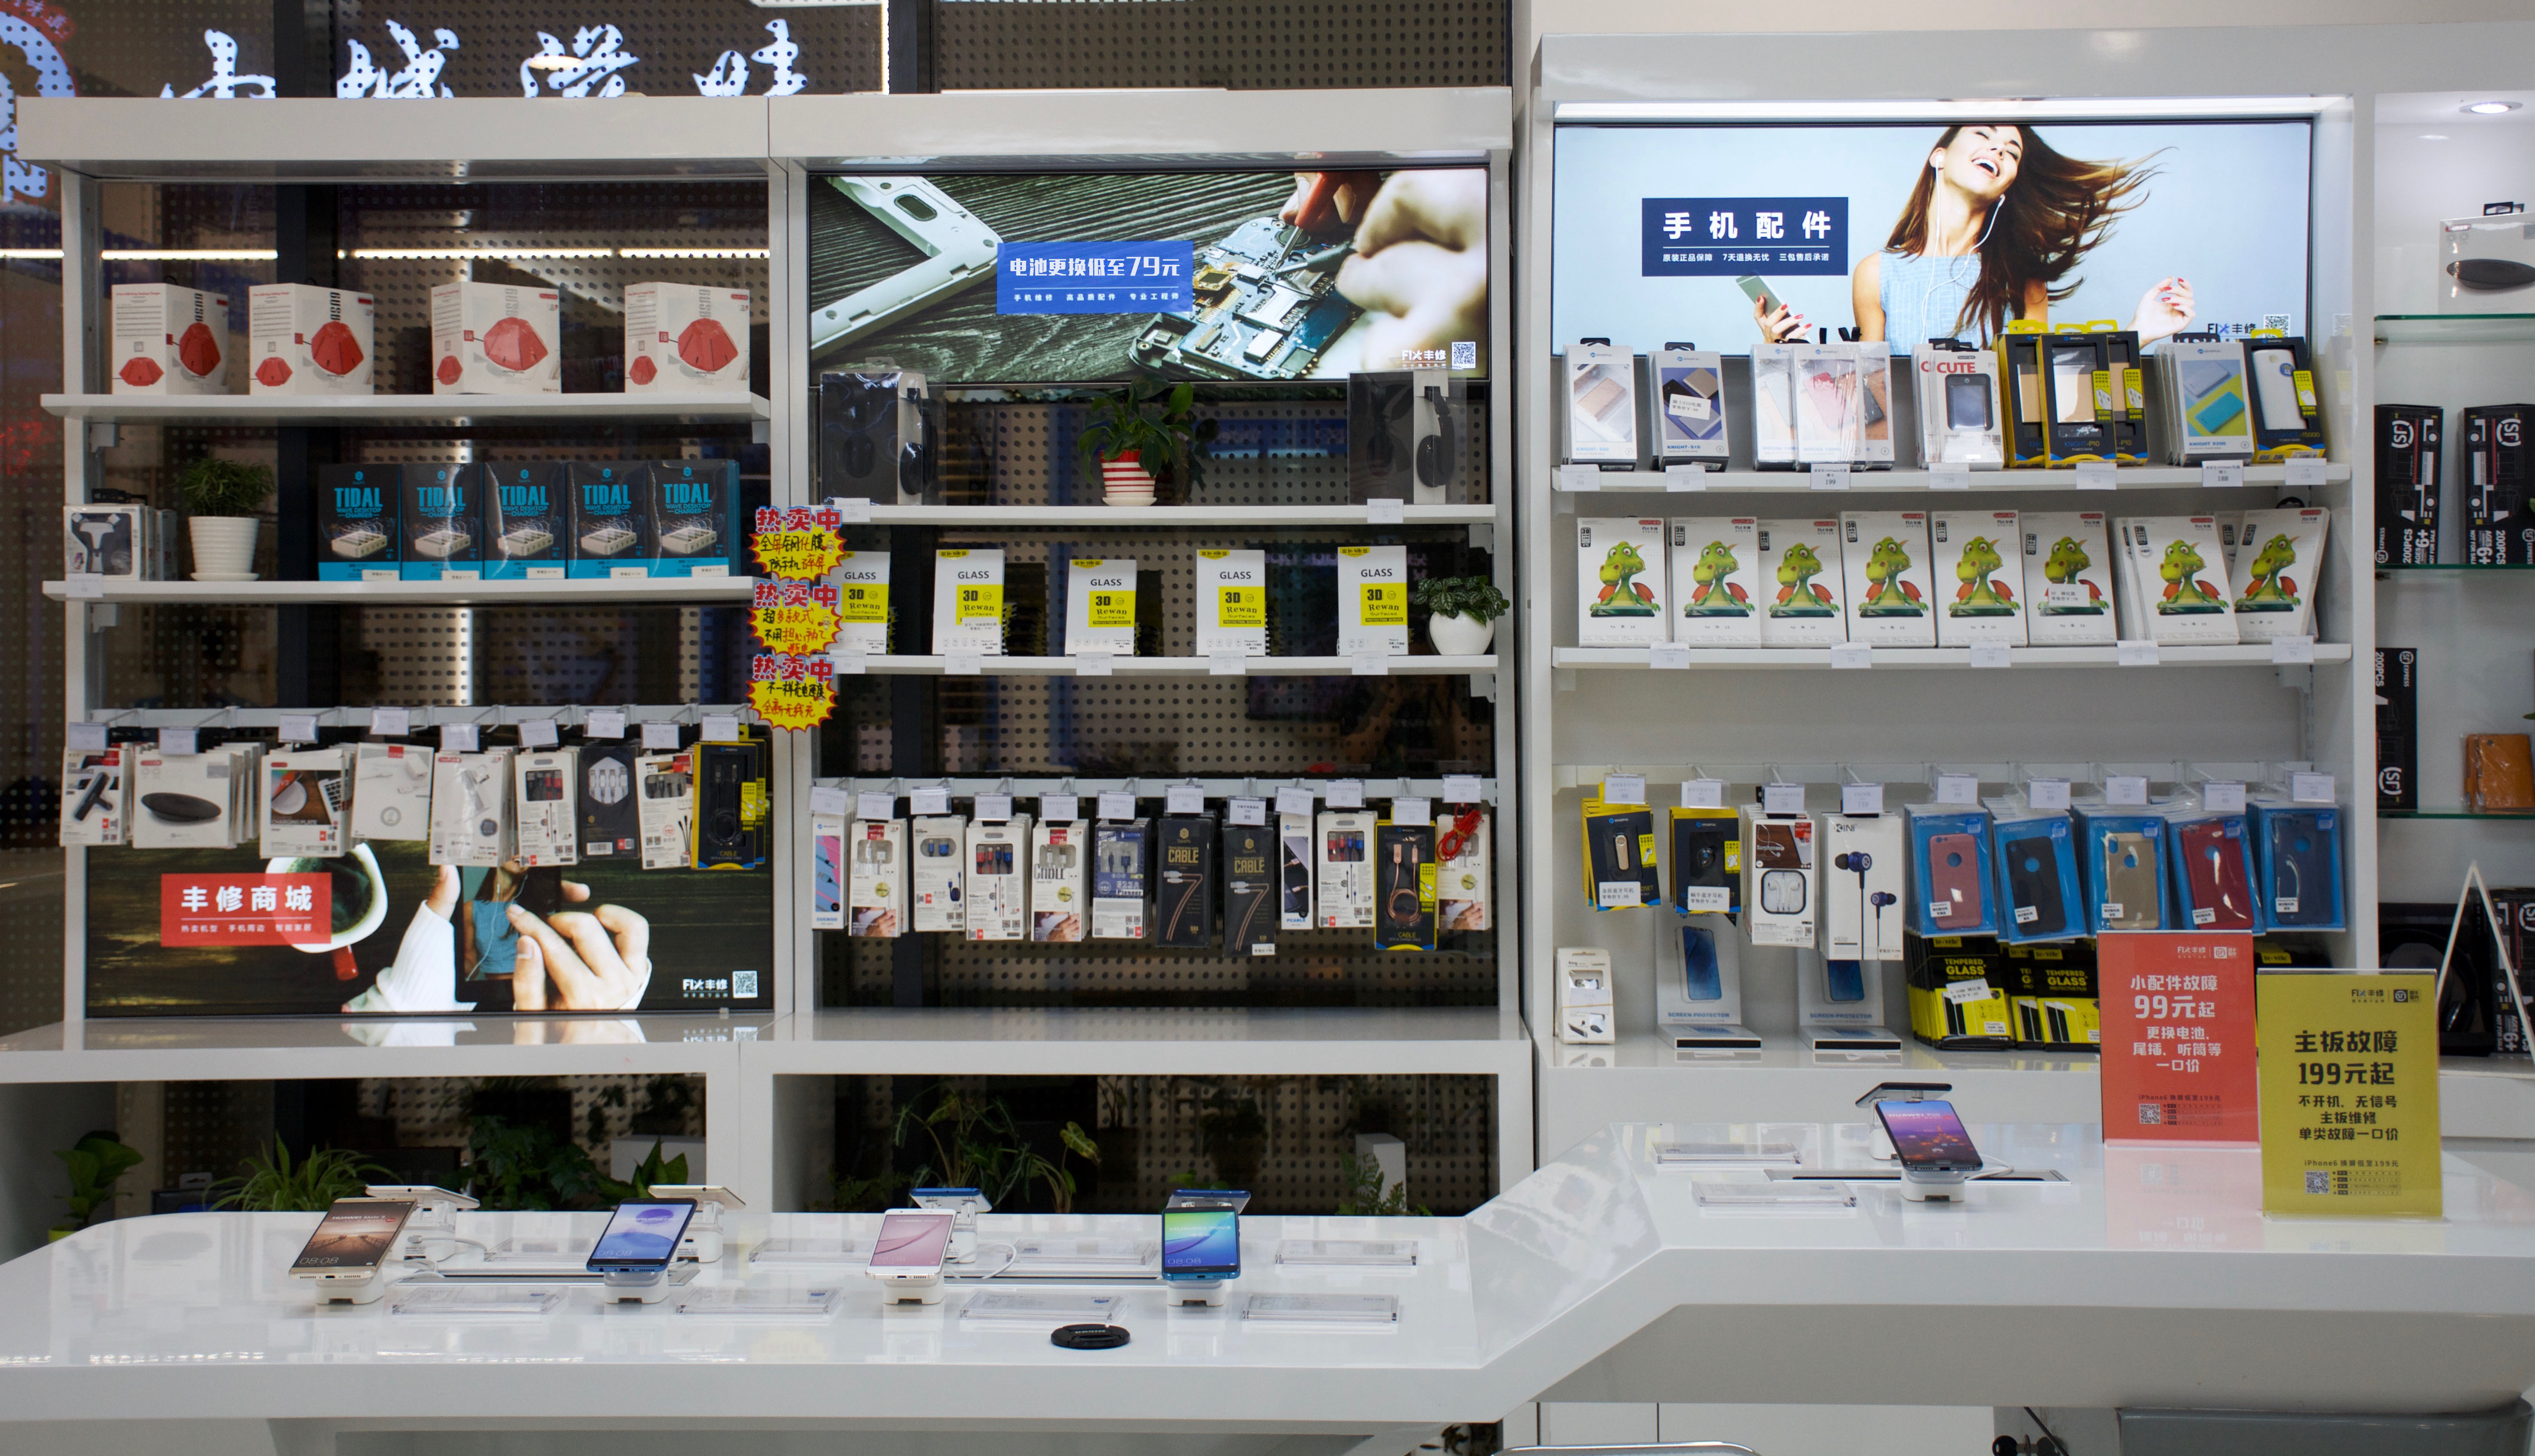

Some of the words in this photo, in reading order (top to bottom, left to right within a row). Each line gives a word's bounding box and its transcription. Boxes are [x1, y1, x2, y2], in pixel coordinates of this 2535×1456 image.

[1663, 211, 1831, 239] 手机配件
[1663, 254, 1713, 262] 原装正品保障
[1723, 253, 1770, 261] 7天退换无忧
[1779, 253, 1829, 261] 三包售后承诺
[1010, 257, 1180, 276] 电池更换低至79元
[1937, 362, 1976, 374] CUTE
[335, 487, 383, 507] TIDAL
[417, 487, 466, 507] TIDAL
[500, 486, 549, 505] TIDAL
[583, 485, 632, 504] TIDAL
[663, 483, 712, 503] TIDAL
[756, 506, 842, 533] 热卖中
[2403, 528, 2413, 564] 200PCS
[2496, 530, 2506, 564] 200PCS
[844, 571, 876, 580] GLASS
[958, 571, 989, 579] GLASS
[1220, 571, 1251, 579] GLASS
[1361, 568, 1392, 577] GLASS
[755, 582, 838, 608] 热卖中
[849, 589, 864, 600] 3D
[963, 590, 978, 601] 3D
[1095, 596, 1111, 606] 3D
[1225, 592, 1240, 603] 3D
[1367, 589, 1382, 601] 3D
[753, 655, 835, 682] 热卖中
[2375, 651, 2384, 687] 200PCS
[1168, 849, 1199, 864] CABLE
[1234, 859, 1264, 874] CABLE
[181, 885, 313, 912] 丰修商城
[1946, 966, 1985, 975] GLASS
[2047, 977, 2087, 986] GLASS
[2131, 975, 2218, 991] 小配件故障
[2135, 995, 2215, 1019] 99元起
[2295, 1030, 2398, 1053] 主板故障
[2156, 1059, 2200, 1072] 一口价
[2299, 1062, 2395, 1085] 199元起
[2320, 1112, 2377, 1125] 主板维修
[2299, 1127, 2399, 1141] 单类故障一口价
[2340, 1159, 2399, 1167] 换屏低至199元
